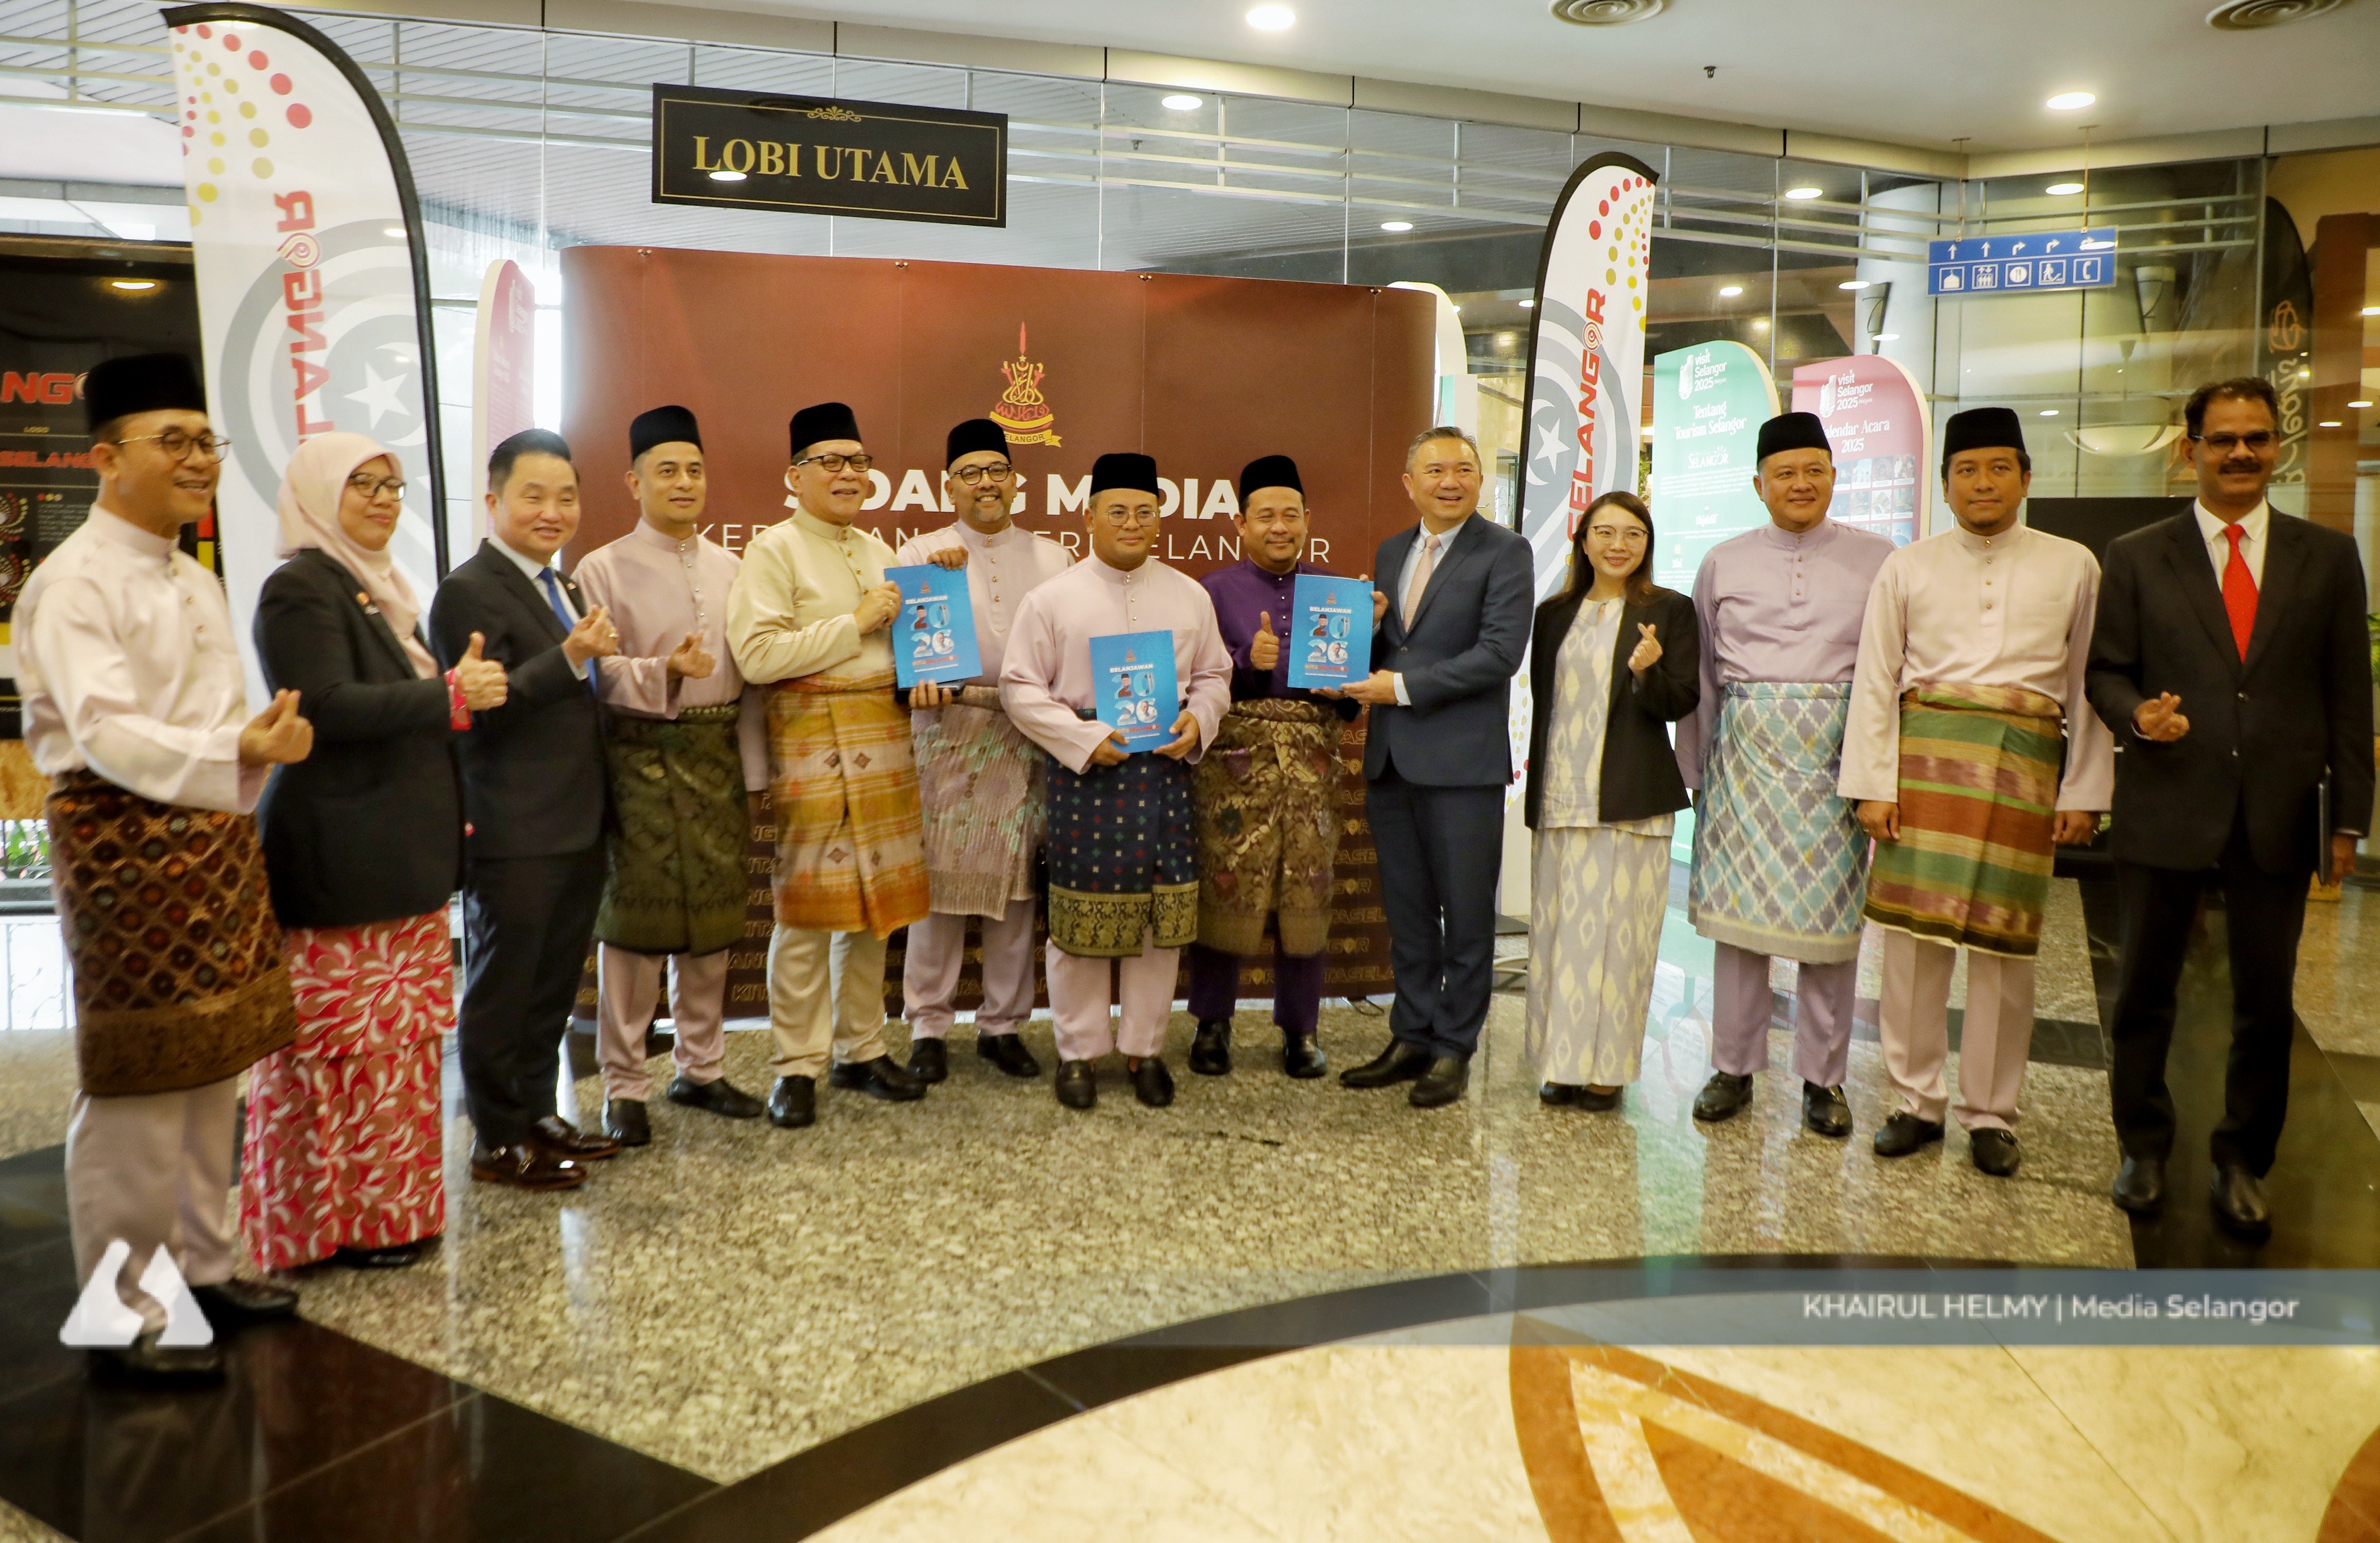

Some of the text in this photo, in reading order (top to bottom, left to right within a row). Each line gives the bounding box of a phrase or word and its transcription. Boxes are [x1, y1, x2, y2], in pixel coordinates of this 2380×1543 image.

[692, 136, 969, 190] LOBI UTAMA
[1695, 348, 1711, 365] visit
[1695, 362, 1727, 378] Selangor
[1838, 369, 1855, 385] visit
[1694, 377, 1714, 392] 2025
[1837, 383, 1874, 398] Selangor
[1693, 401, 1727, 419] Tentang
[1836, 397, 1858, 411] 2025
[1674, 417, 1747, 440] Tourism Selangor
[1823, 419, 1890, 439] alendar Acara
[1005, 433, 1045, 443] ELANGOR
[1841, 437, 1865, 453] 2025
[1688, 449, 1728, 469] SELANGOR
[1047, 474, 1239, 520] MDIA
[911, 629, 954, 658] 26
[1307, 639, 1348, 665] 26
[1110, 663, 1153, 674] BELANJAWAN
[1114, 698, 1158, 726] 26
